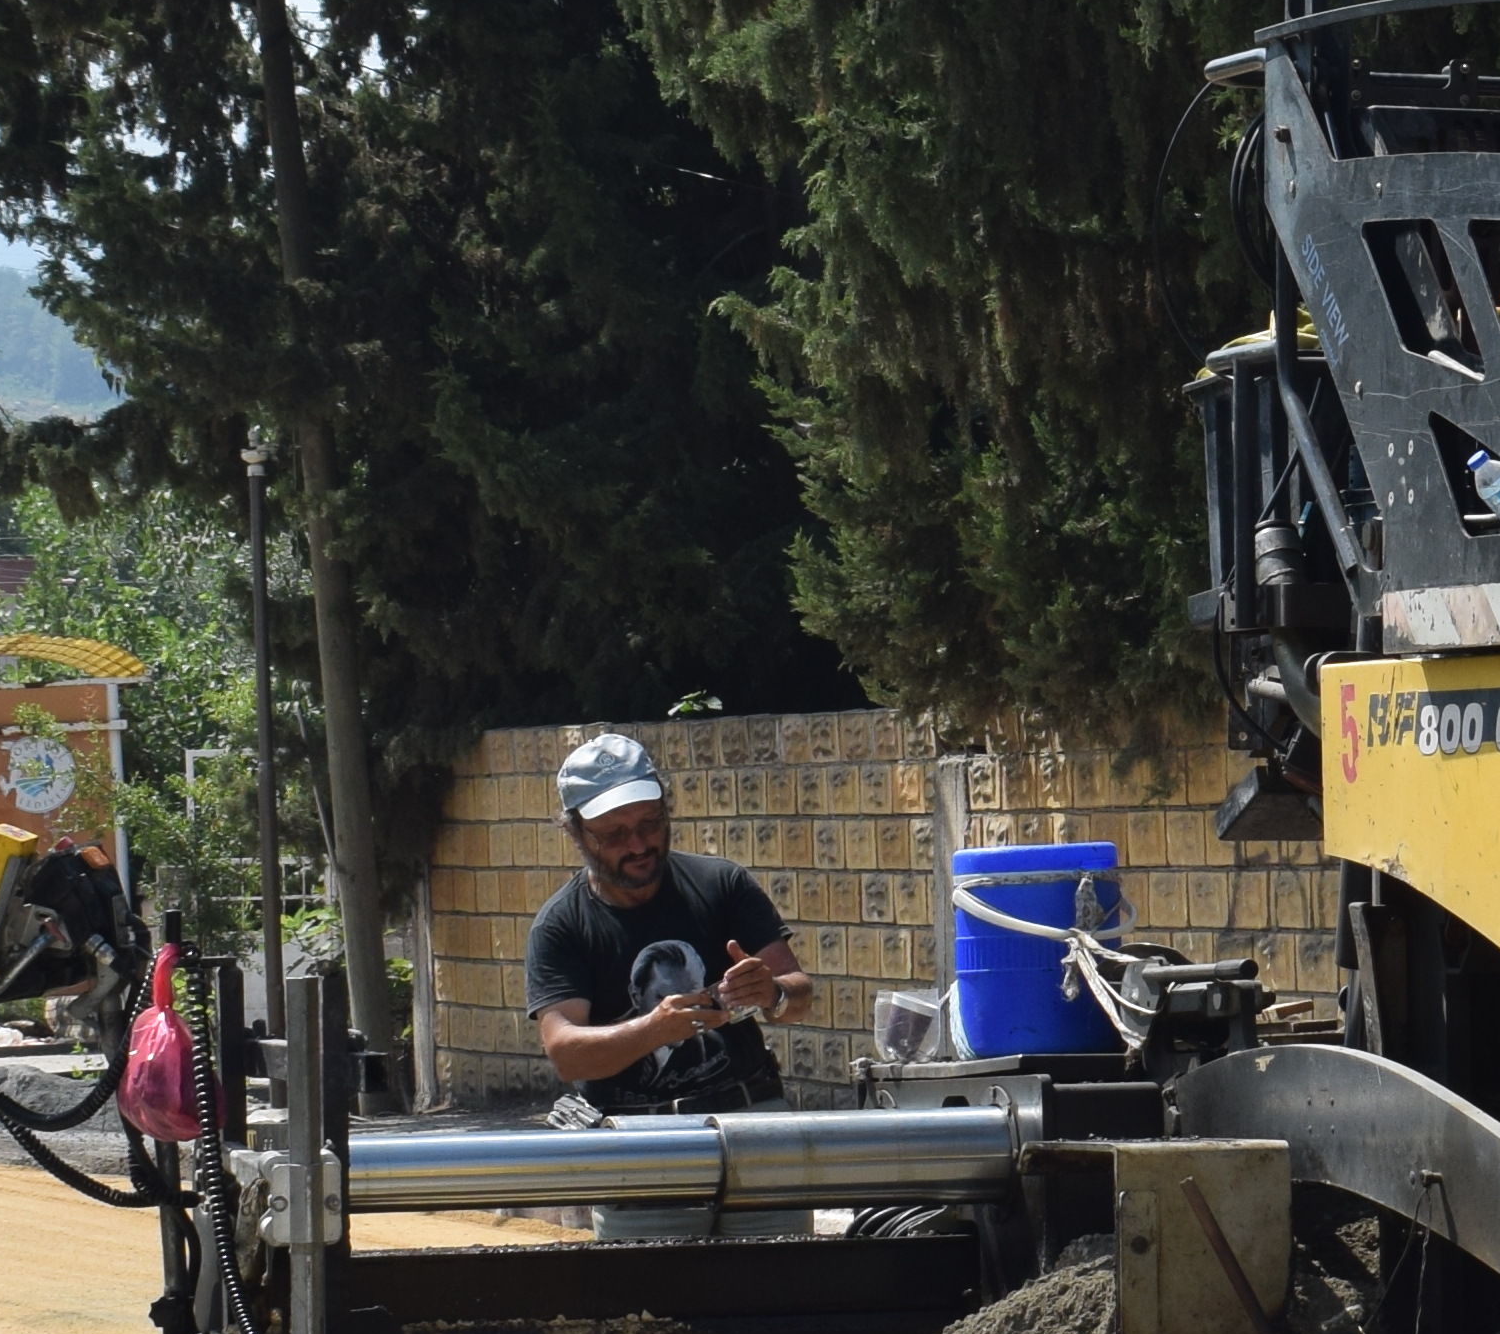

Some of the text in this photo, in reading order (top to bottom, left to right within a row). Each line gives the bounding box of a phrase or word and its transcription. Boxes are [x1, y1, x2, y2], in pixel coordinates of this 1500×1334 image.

[1302, 233, 1325, 289] SIDE
[1322, 281, 1350, 347] VIEW
[1340, 683, 1360, 784] 5
